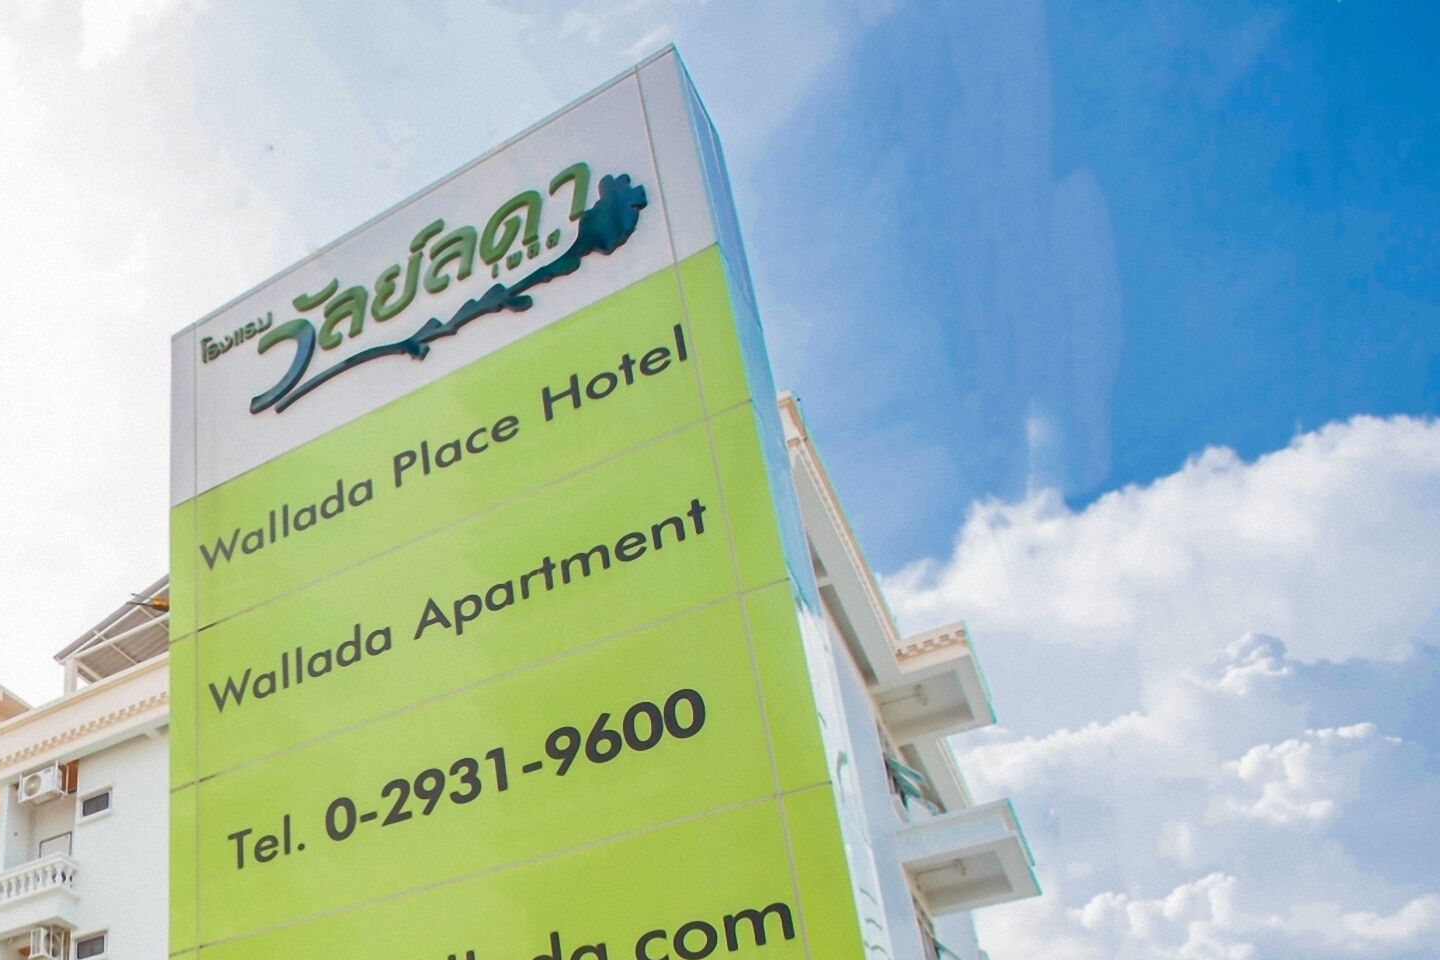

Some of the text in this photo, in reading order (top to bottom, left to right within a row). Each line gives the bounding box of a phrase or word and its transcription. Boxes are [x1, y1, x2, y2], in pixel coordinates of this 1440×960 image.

[201, 311, 273, 364] โรงแรม
[249, 162, 591, 414] วัลย์ลดา
[200, 323, 688, 570] Wallada Place Hotel
[209, 499, 707, 712] Wallada Apartment
[228, 689, 707, 869] Tel. 0-2931-9600
